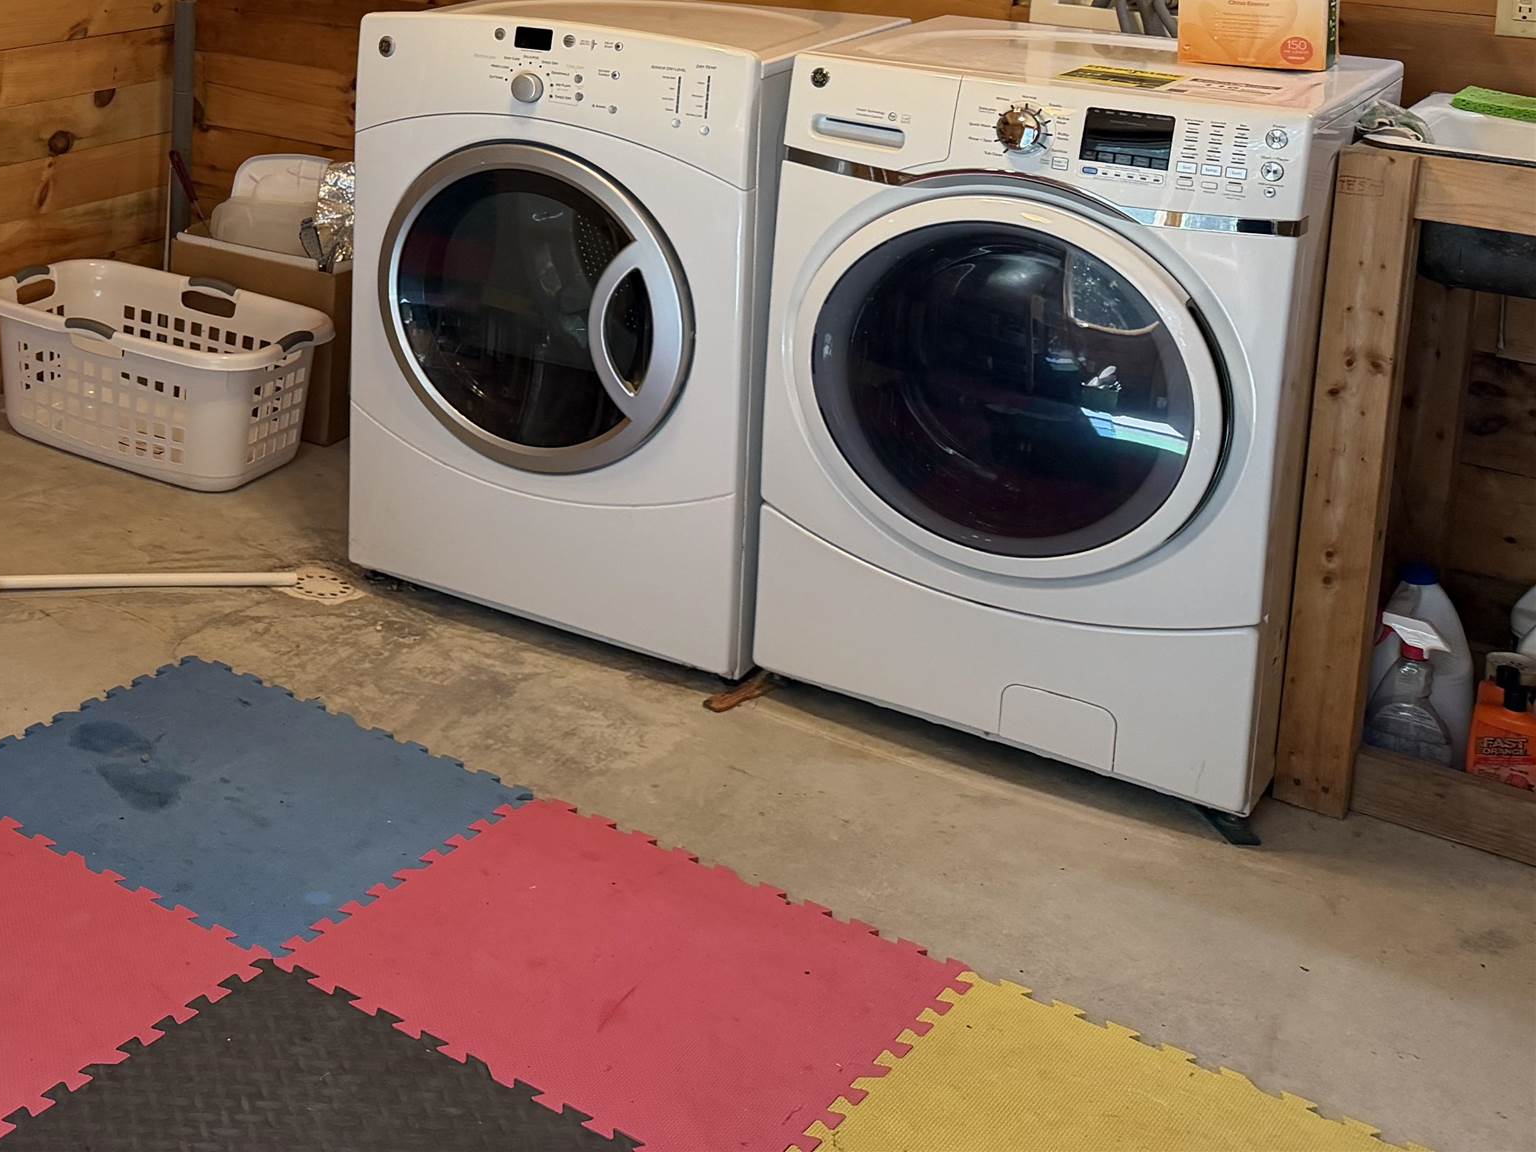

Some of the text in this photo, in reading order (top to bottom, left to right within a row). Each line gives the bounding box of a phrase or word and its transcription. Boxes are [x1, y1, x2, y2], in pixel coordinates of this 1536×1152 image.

[1287, 40, 1307, 49] 150
[1481, 737, 1528, 748] FAST
[1481, 748, 1526, 756] ORANGE
